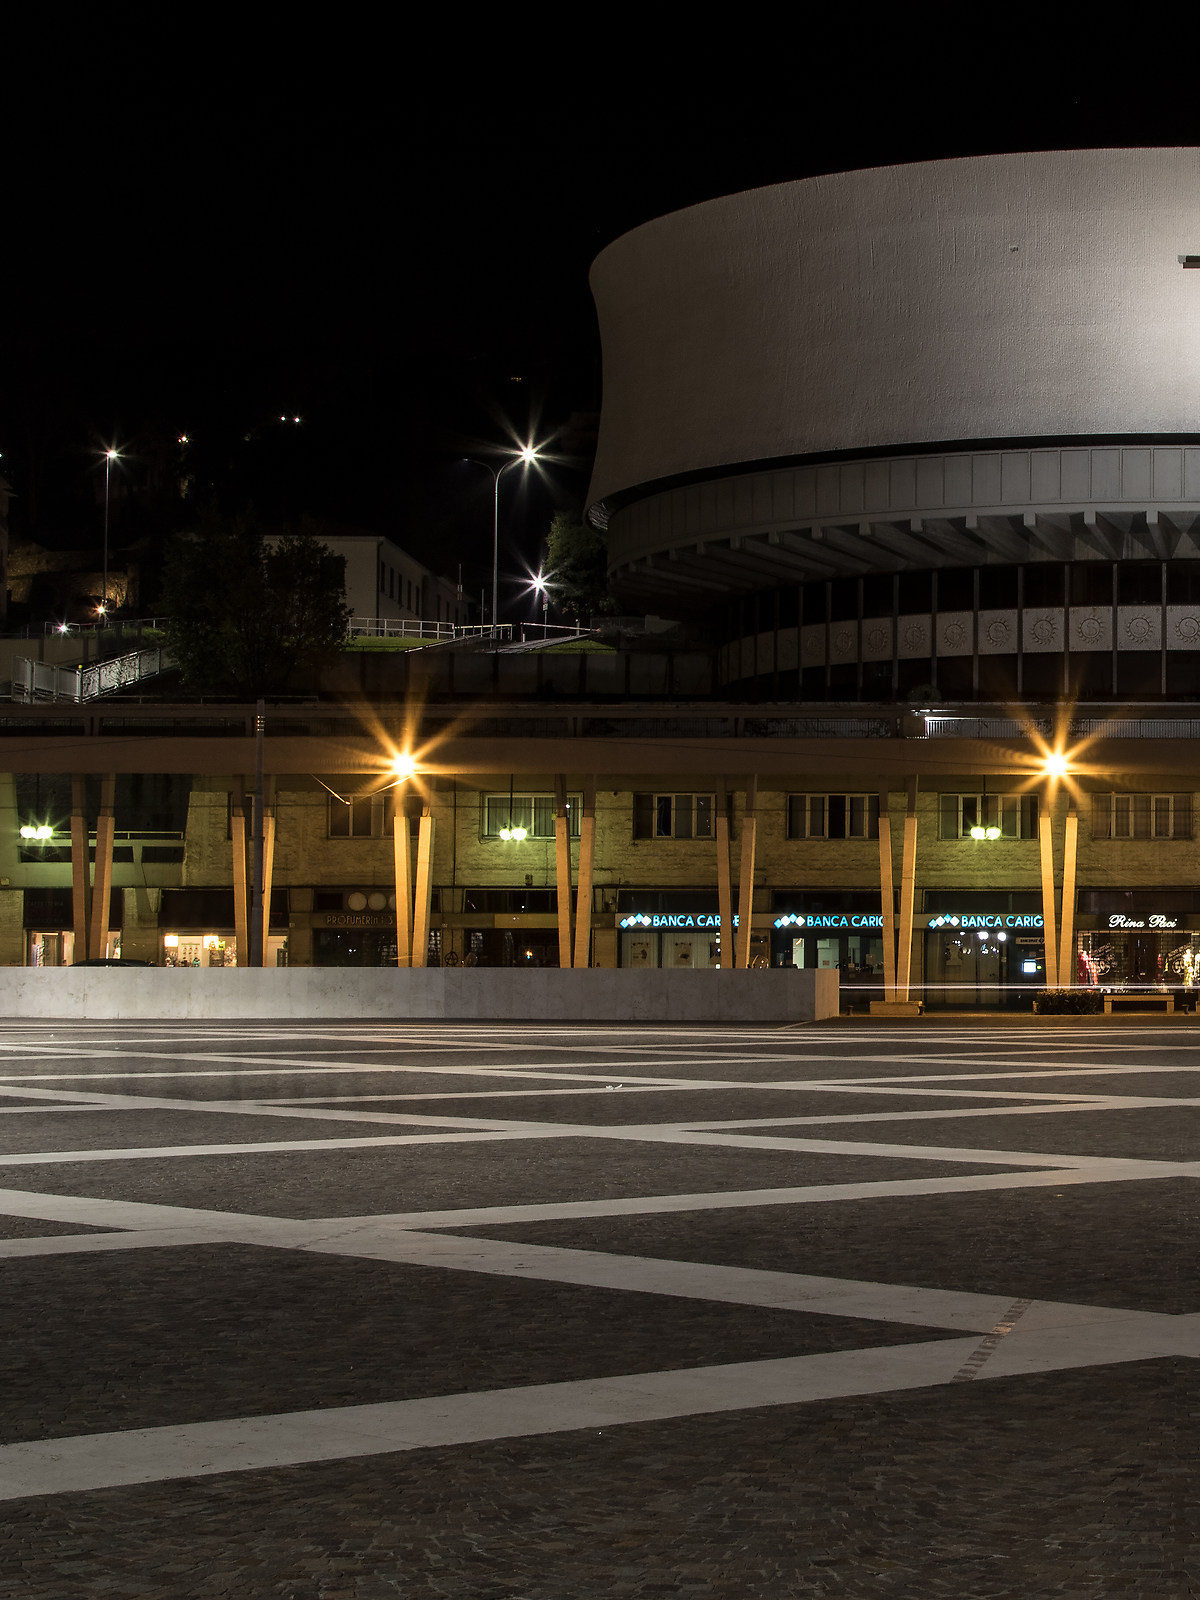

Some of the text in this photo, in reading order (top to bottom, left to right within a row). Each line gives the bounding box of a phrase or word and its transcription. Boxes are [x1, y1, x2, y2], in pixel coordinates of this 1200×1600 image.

[652, 915, 740, 927] BANCA CARE
[806, 915, 849, 927] BANCA
[961, 915, 1044, 927] BANCA CARIG
[1108, 914, 1145, 928] Rina
